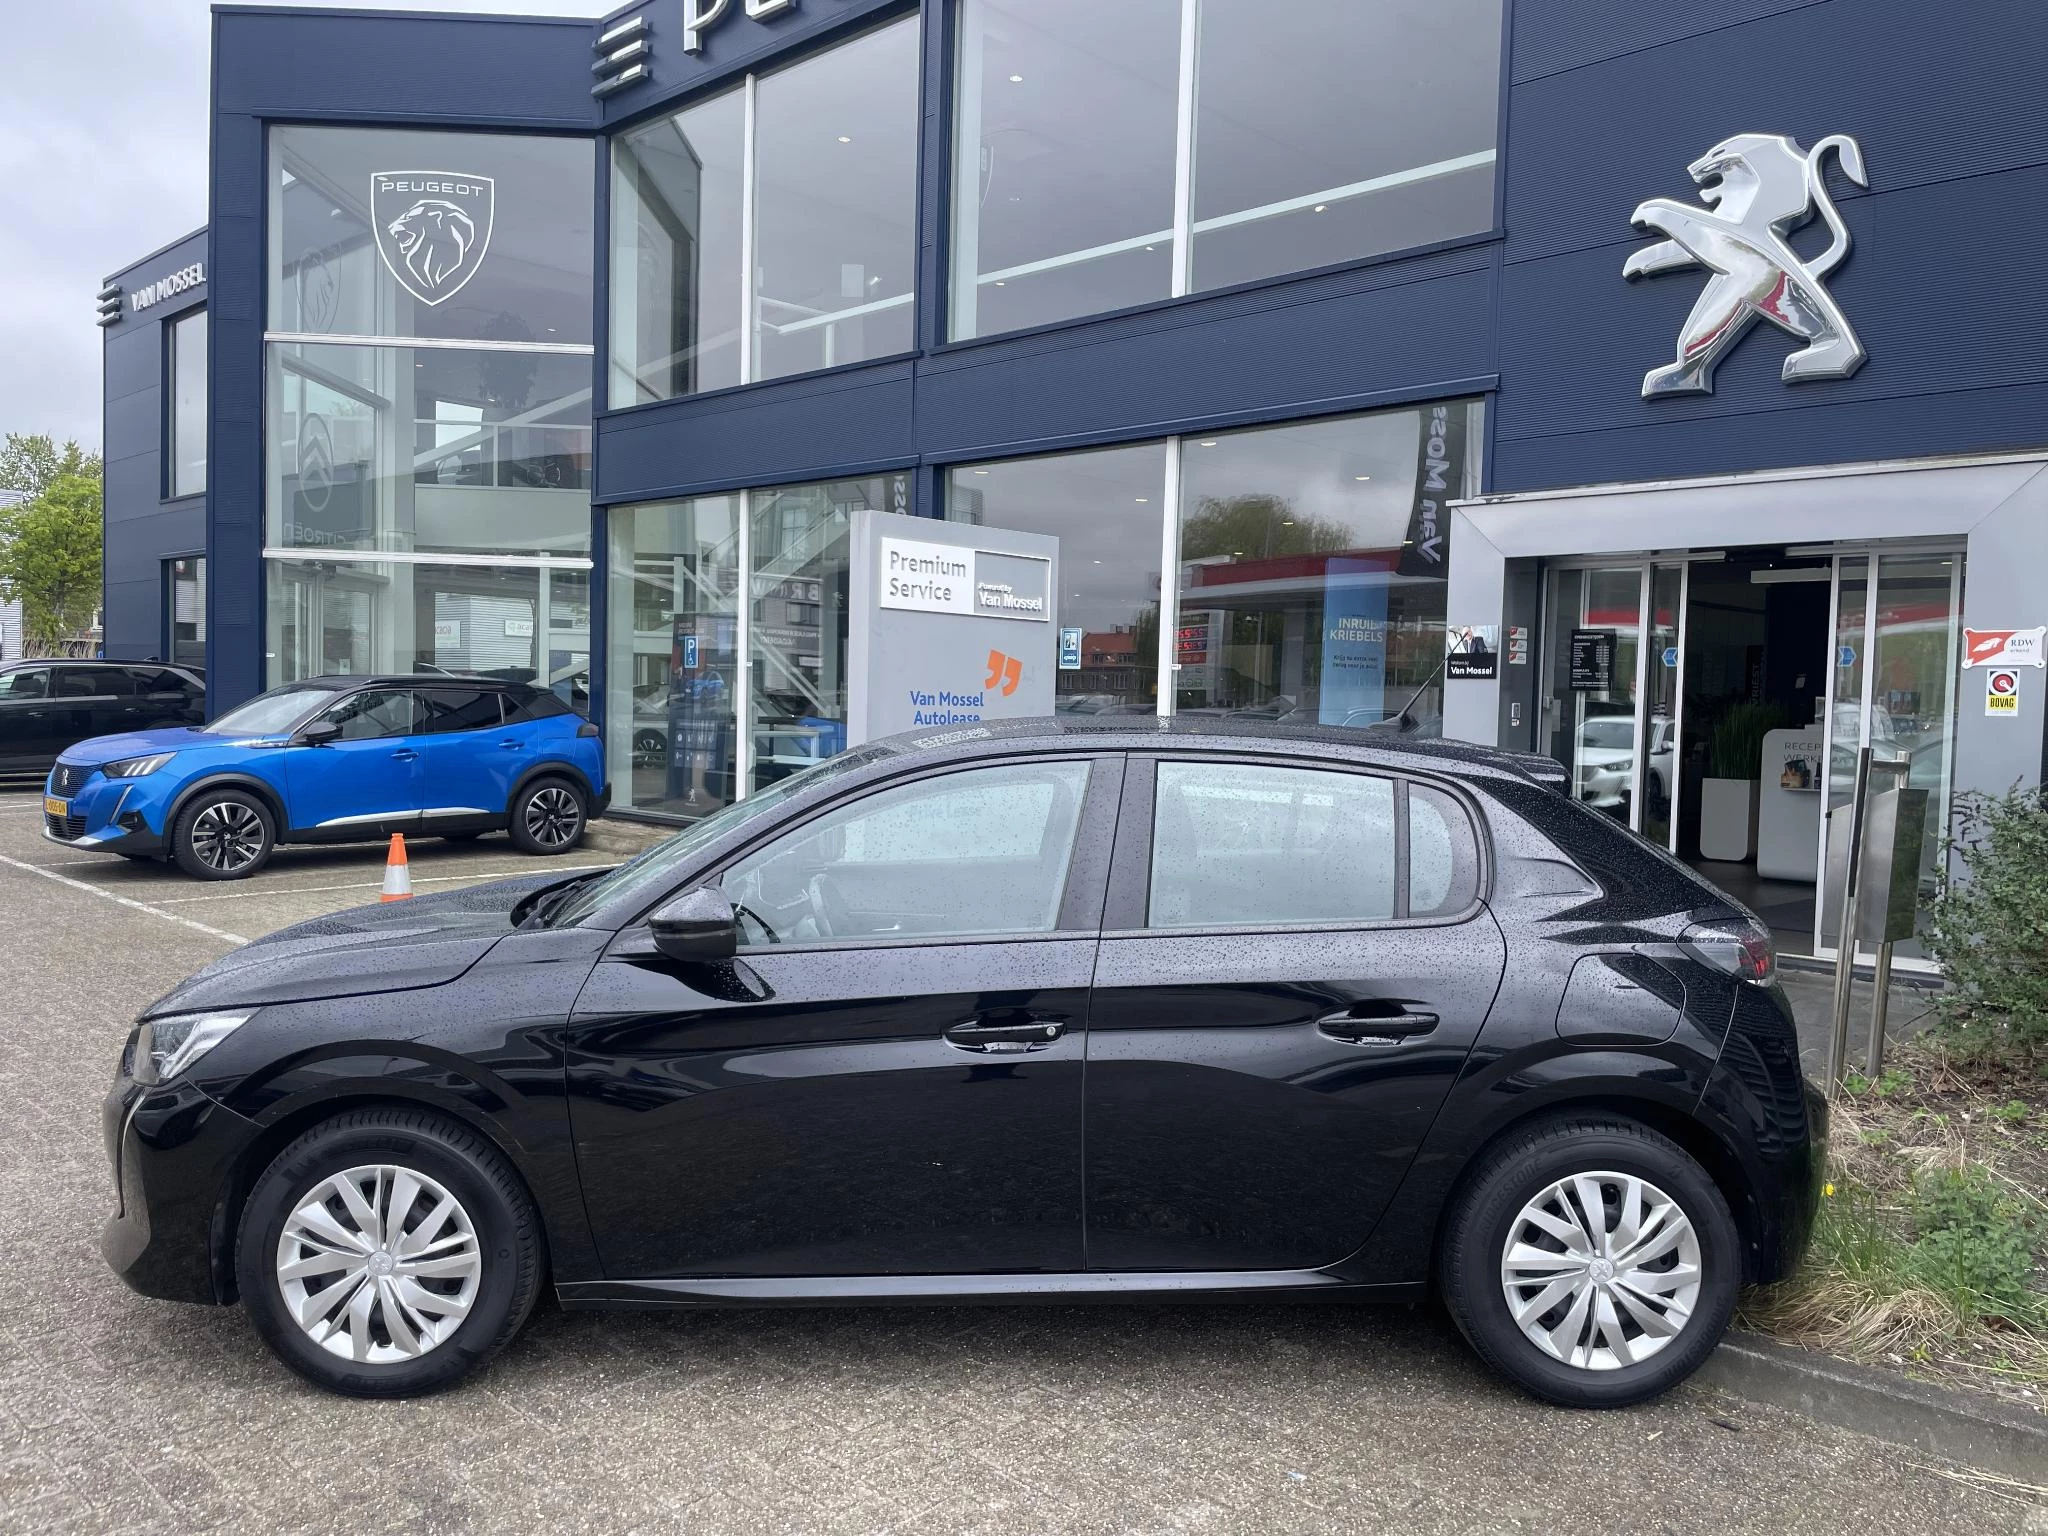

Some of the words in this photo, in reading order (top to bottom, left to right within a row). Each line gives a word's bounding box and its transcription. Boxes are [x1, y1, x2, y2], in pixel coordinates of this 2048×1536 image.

[381, 180, 484, 197] PEUGEOT
[131, 285, 156, 312] VAN
[157, 262, 207, 301] MOSSEL
[889, 550, 967, 578] Premium
[889, 577, 952, 602] Service
[979, 591, 1001, 606] Van
[1003, 593, 1043, 610] Mossel
[1329, 628, 1384, 643] KRIEBELS
[2010, 638, 2035, 647] RDW
[687, 639, 696, 654] P
[1451, 667, 1465, 675] Van
[1466, 666, 1493, 675] Mossel
[909, 690, 936, 706] Van
[939, 691, 985, 707] Mossel
[1990, 697, 2015, 708] BOVAG
[913, 709, 981, 726] Autolease
